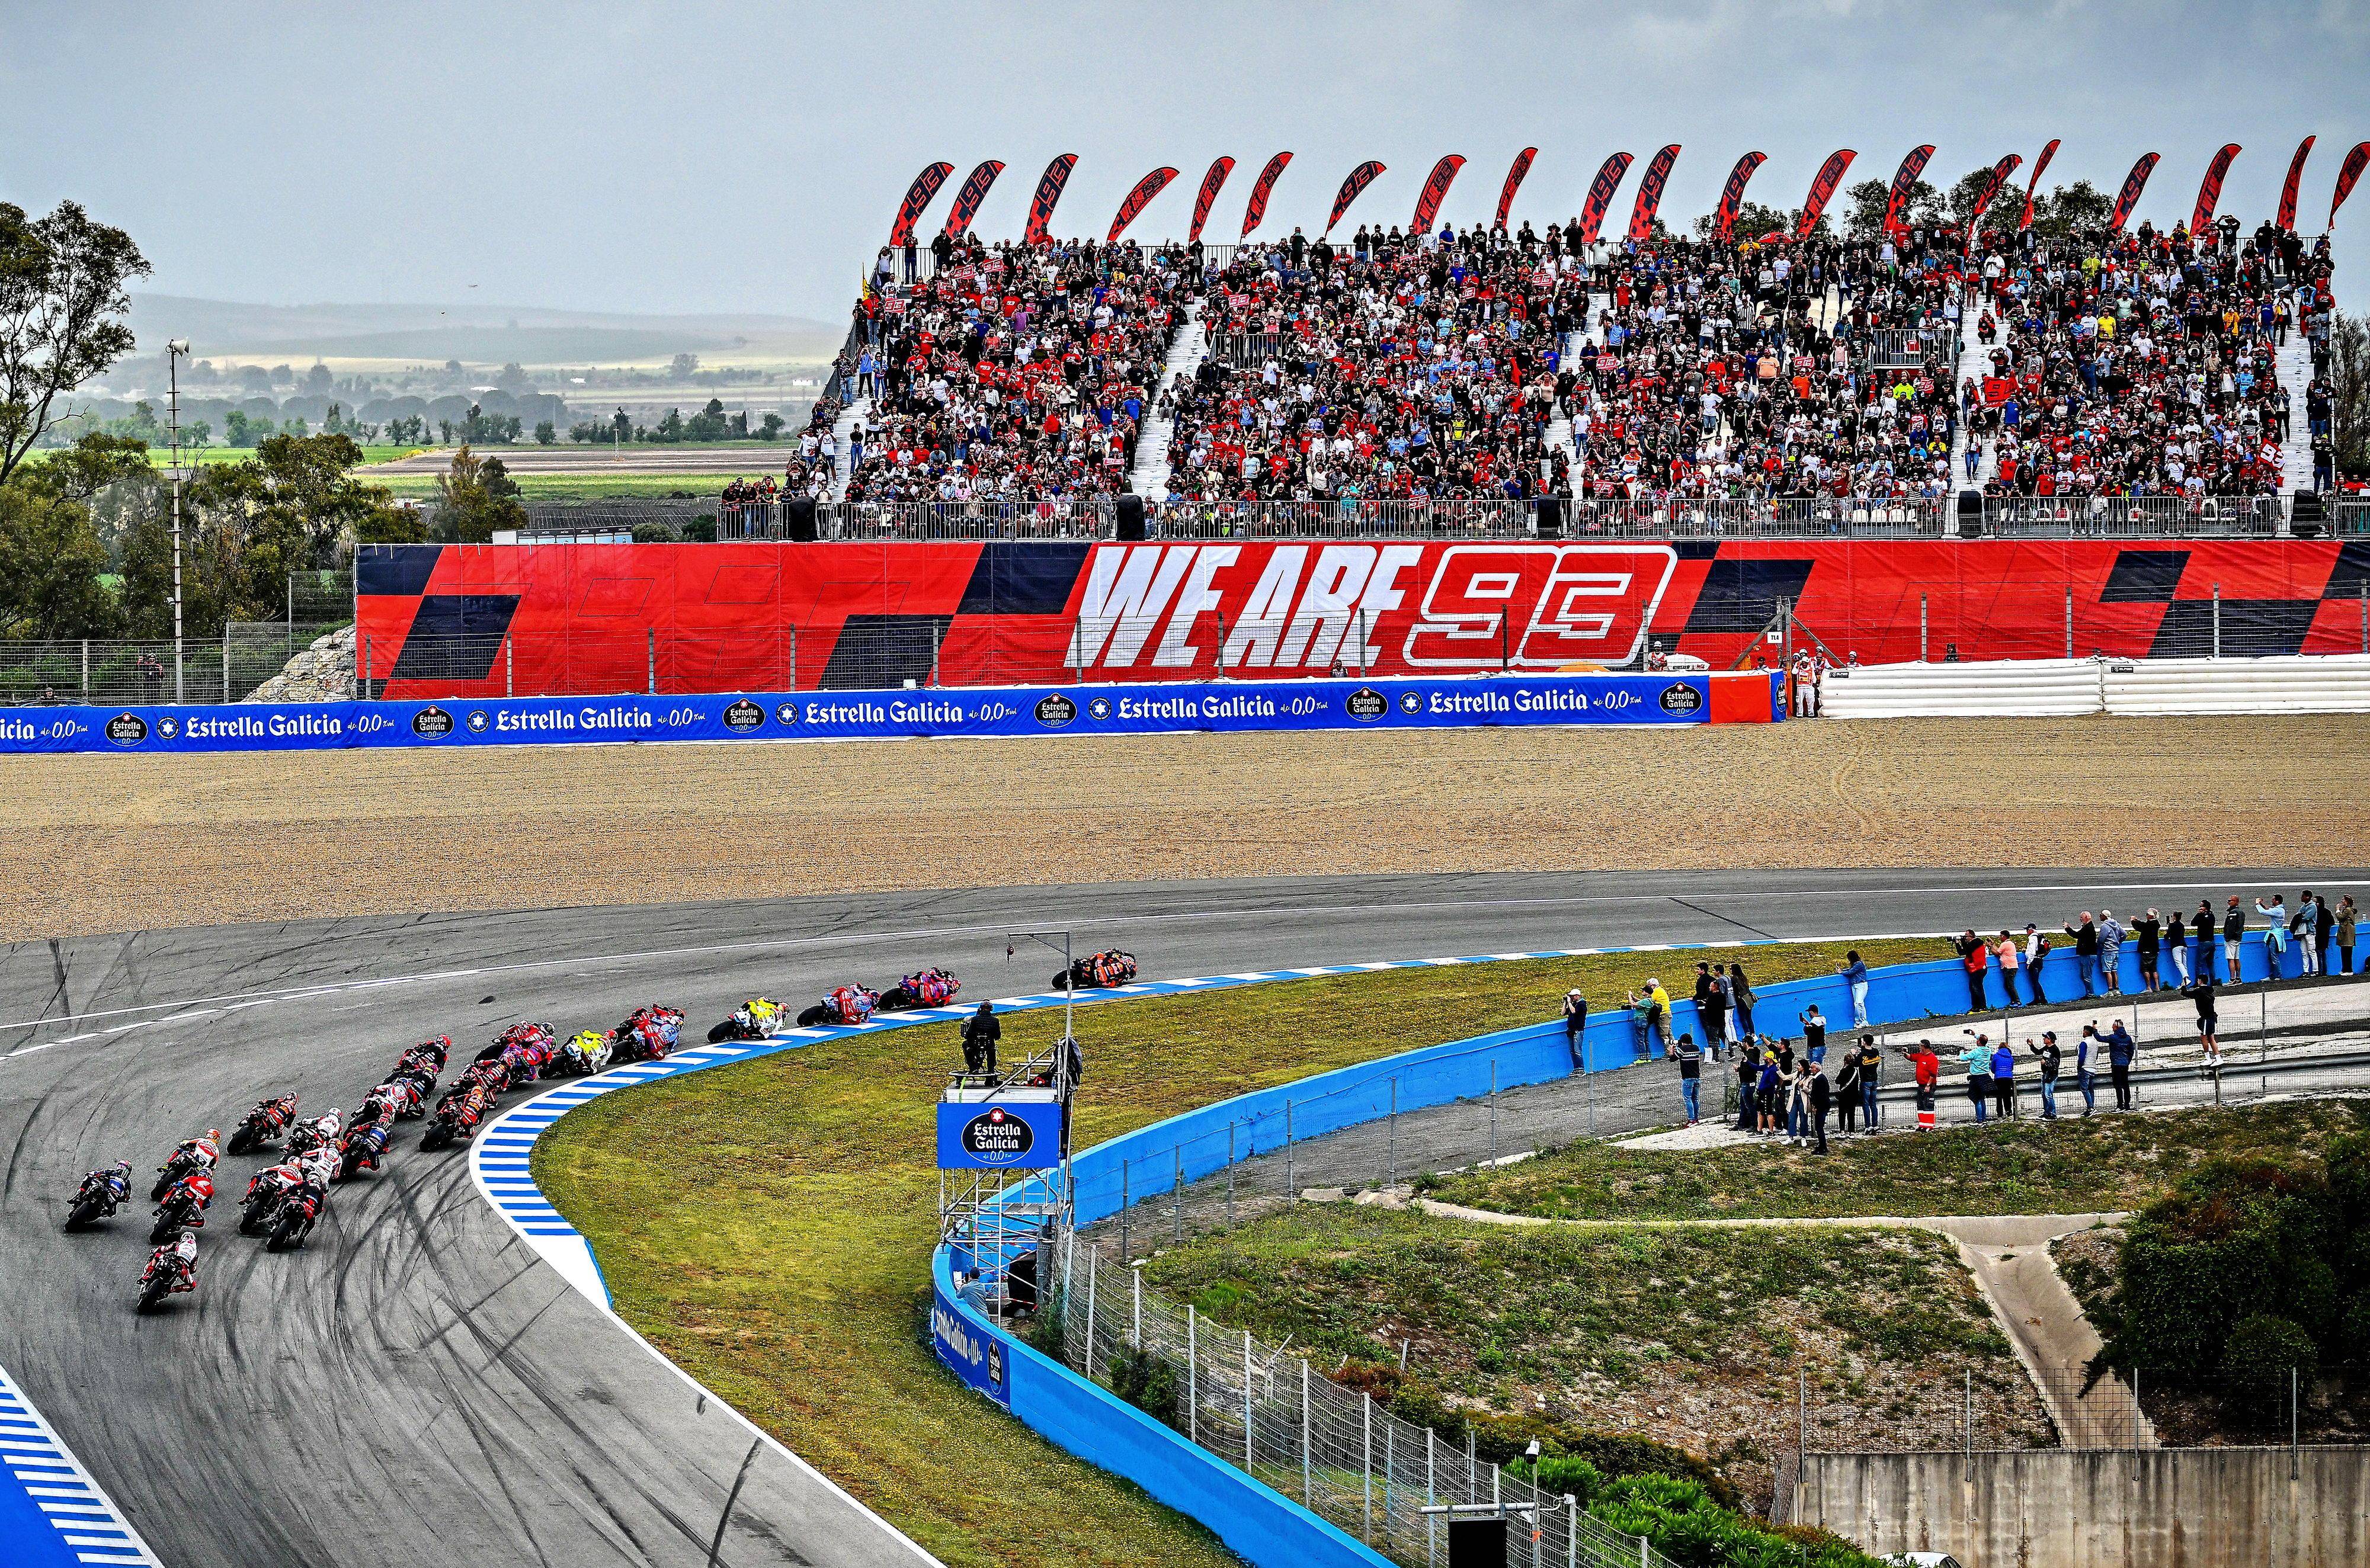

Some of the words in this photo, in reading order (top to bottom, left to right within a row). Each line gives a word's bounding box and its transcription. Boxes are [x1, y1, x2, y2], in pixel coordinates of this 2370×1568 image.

[1208, 161, 1226, 193] 93
[1434, 159, 1456, 191] 93
[1822, 154, 1845, 188] 93
[1591, 159, 1621, 207] 93
[1642, 155, 1670, 201] 93
[1725, 158, 1753, 201] 93
[906, 166, 940, 214] 93
[958, 166, 991, 214] 93
[1036, 161, 1066, 210] 93
[1339, 165, 1370, 209] 93
[984, 259, 1003, 272] 93
[955, 265, 973, 280] 93
[1533, 274, 1553, 286] 93
[885, 299, 904, 312] 93
[1229, 294, 1250, 307] 93
[1597, 357, 1618, 369] 93
[2262, 443, 2286, 469] 93
[1593, 482, 1614, 493] 93
[1065, 545, 1241, 668] WE
[1216, 545, 1424, 668] ARE
[1402, 544, 1678, 668] 93
[1352, 697, 1380, 705] Estrella
[1429, 692, 1510, 713] Estrella
[1514, 689, 1588, 711] Galicia
[1604, 690, 1629, 709] 0,0
[1666, 692, 1695, 700] Estrella
[1041, 703, 1069, 711] Estrella
[1118, 698, 1197, 719] Estrella
[1203, 695, 1275, 717] Galicia
[1292, 696, 1315, 715] 0,0
[1353, 704, 1379, 713] Galicia
[1667, 700, 1693, 708] Galicia
[419, 714, 446, 723] Estrella
[496, 710, 575, 730] Estrella
[580, 707, 652, 729] Galicia
[669, 707, 693, 726] 0,0
[729, 708, 758, 717] Estrella
[805, 703, 885, 723] Estrella
[890, 701, 963, 722] Galicia
[980, 703, 1004, 722] 0,0
[1042, 710, 1068, 718] Galicia
[113, 722, 141, 730] Estrella
[185, 717, 265, 737] Estrella
[270, 714, 342, 736] Galicia
[358, 714, 382, 733] 0,0
[419, 722, 445, 730] Galicia
[731, 716, 757, 724] Galicia
[0, 719, 36, 739] icia
[52, 719, 75, 739] 0,0
[113, 729, 140, 737] Galicia
[973, 1123, 1021, 1136] Estrella
[975, 1136, 1019, 1149] Galicia
[989, 1150, 1004, 1161] 0,0
[950, 1314, 968, 1360] Galicia
